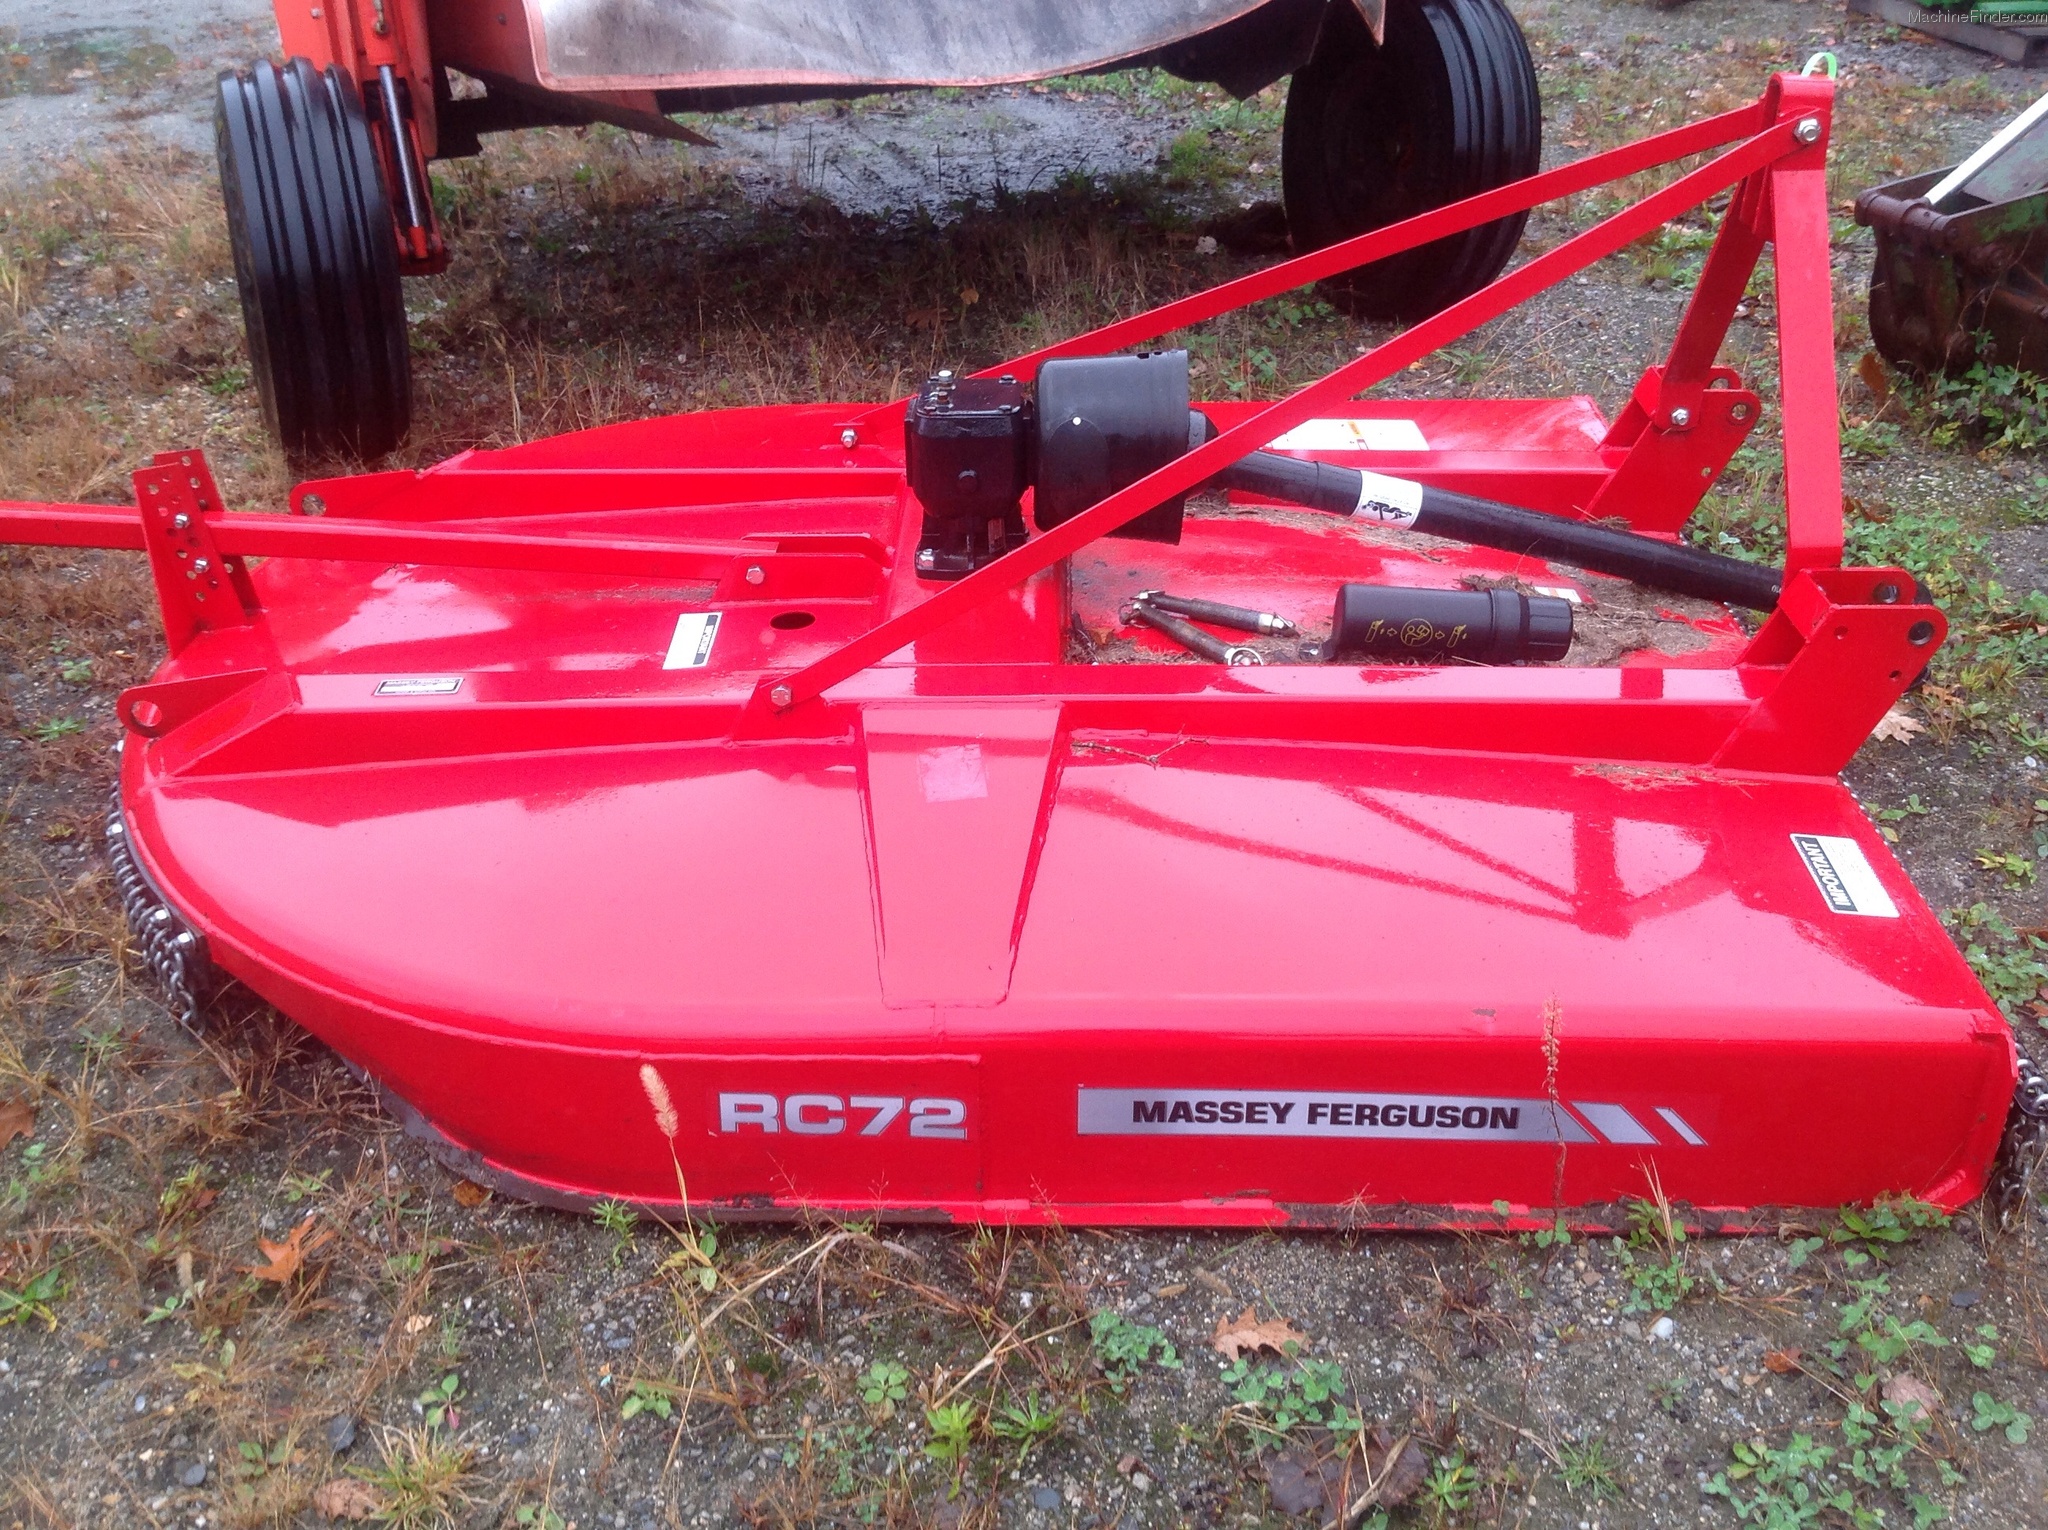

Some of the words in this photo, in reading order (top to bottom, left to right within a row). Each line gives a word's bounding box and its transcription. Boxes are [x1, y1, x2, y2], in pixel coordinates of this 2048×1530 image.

[1800, 840, 1852, 907] IMPORTANT
[719, 1092, 967, 1140] RC72
[1132, 1100, 1296, 1124] MASSEY
[1307, 1102, 1520, 1129] FERGUSON
